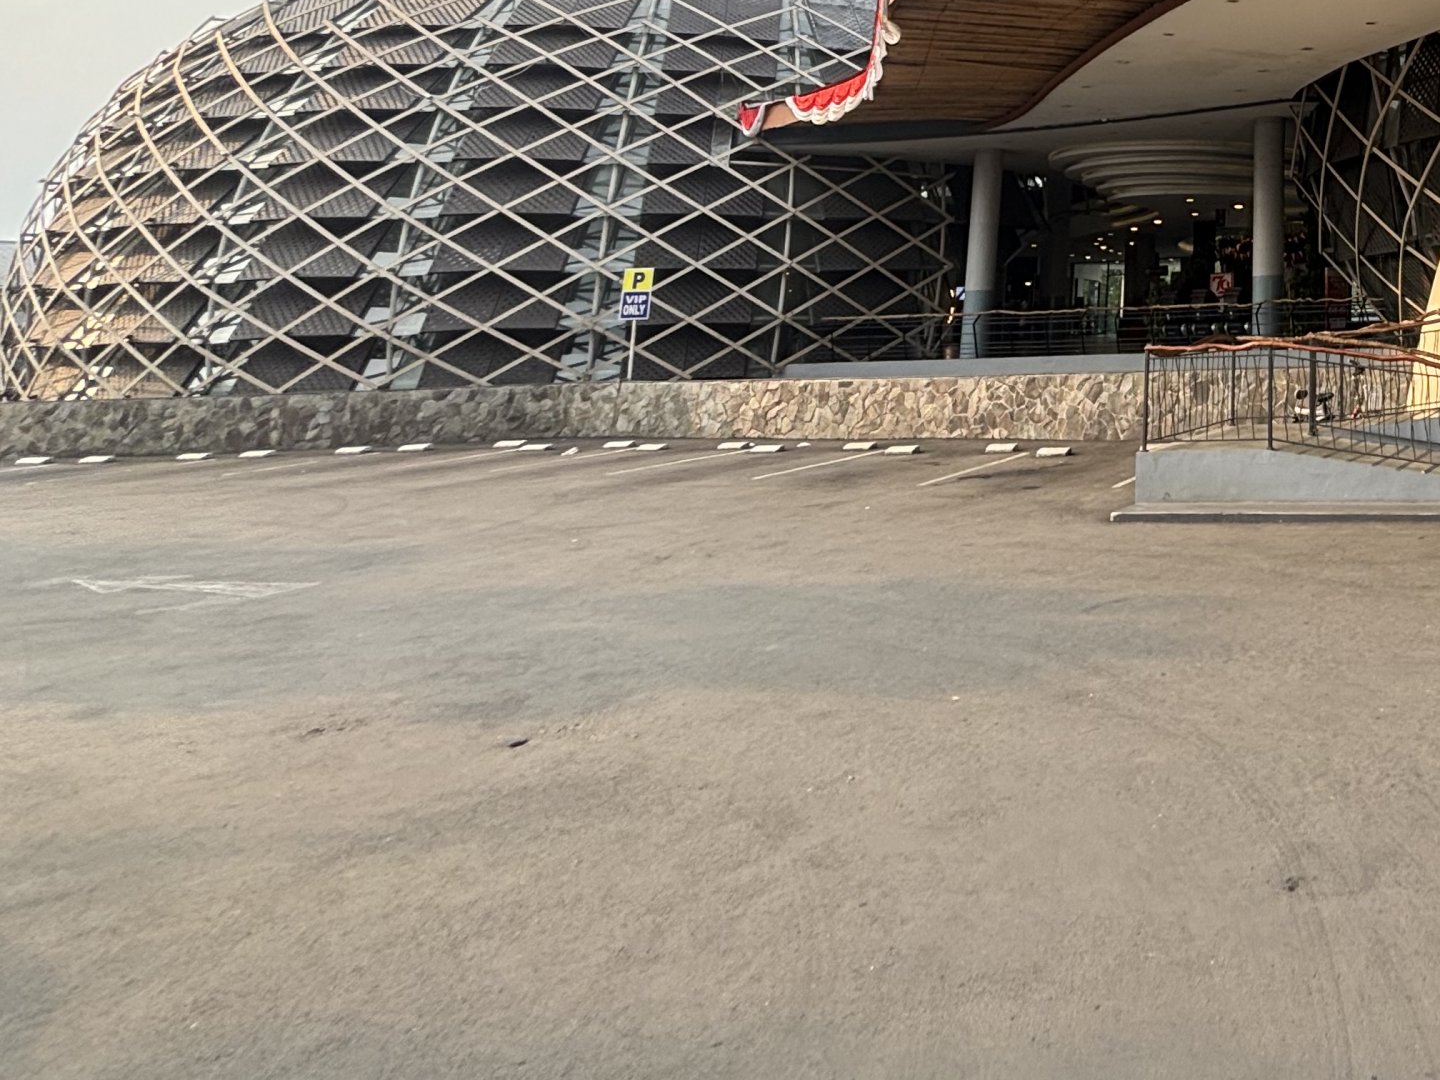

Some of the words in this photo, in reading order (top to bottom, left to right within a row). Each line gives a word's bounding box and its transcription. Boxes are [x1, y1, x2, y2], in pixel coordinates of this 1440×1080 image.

[632, 272, 646, 289] P
[625, 295, 647, 304] VIP
[623, 305, 645, 316] ONLY
